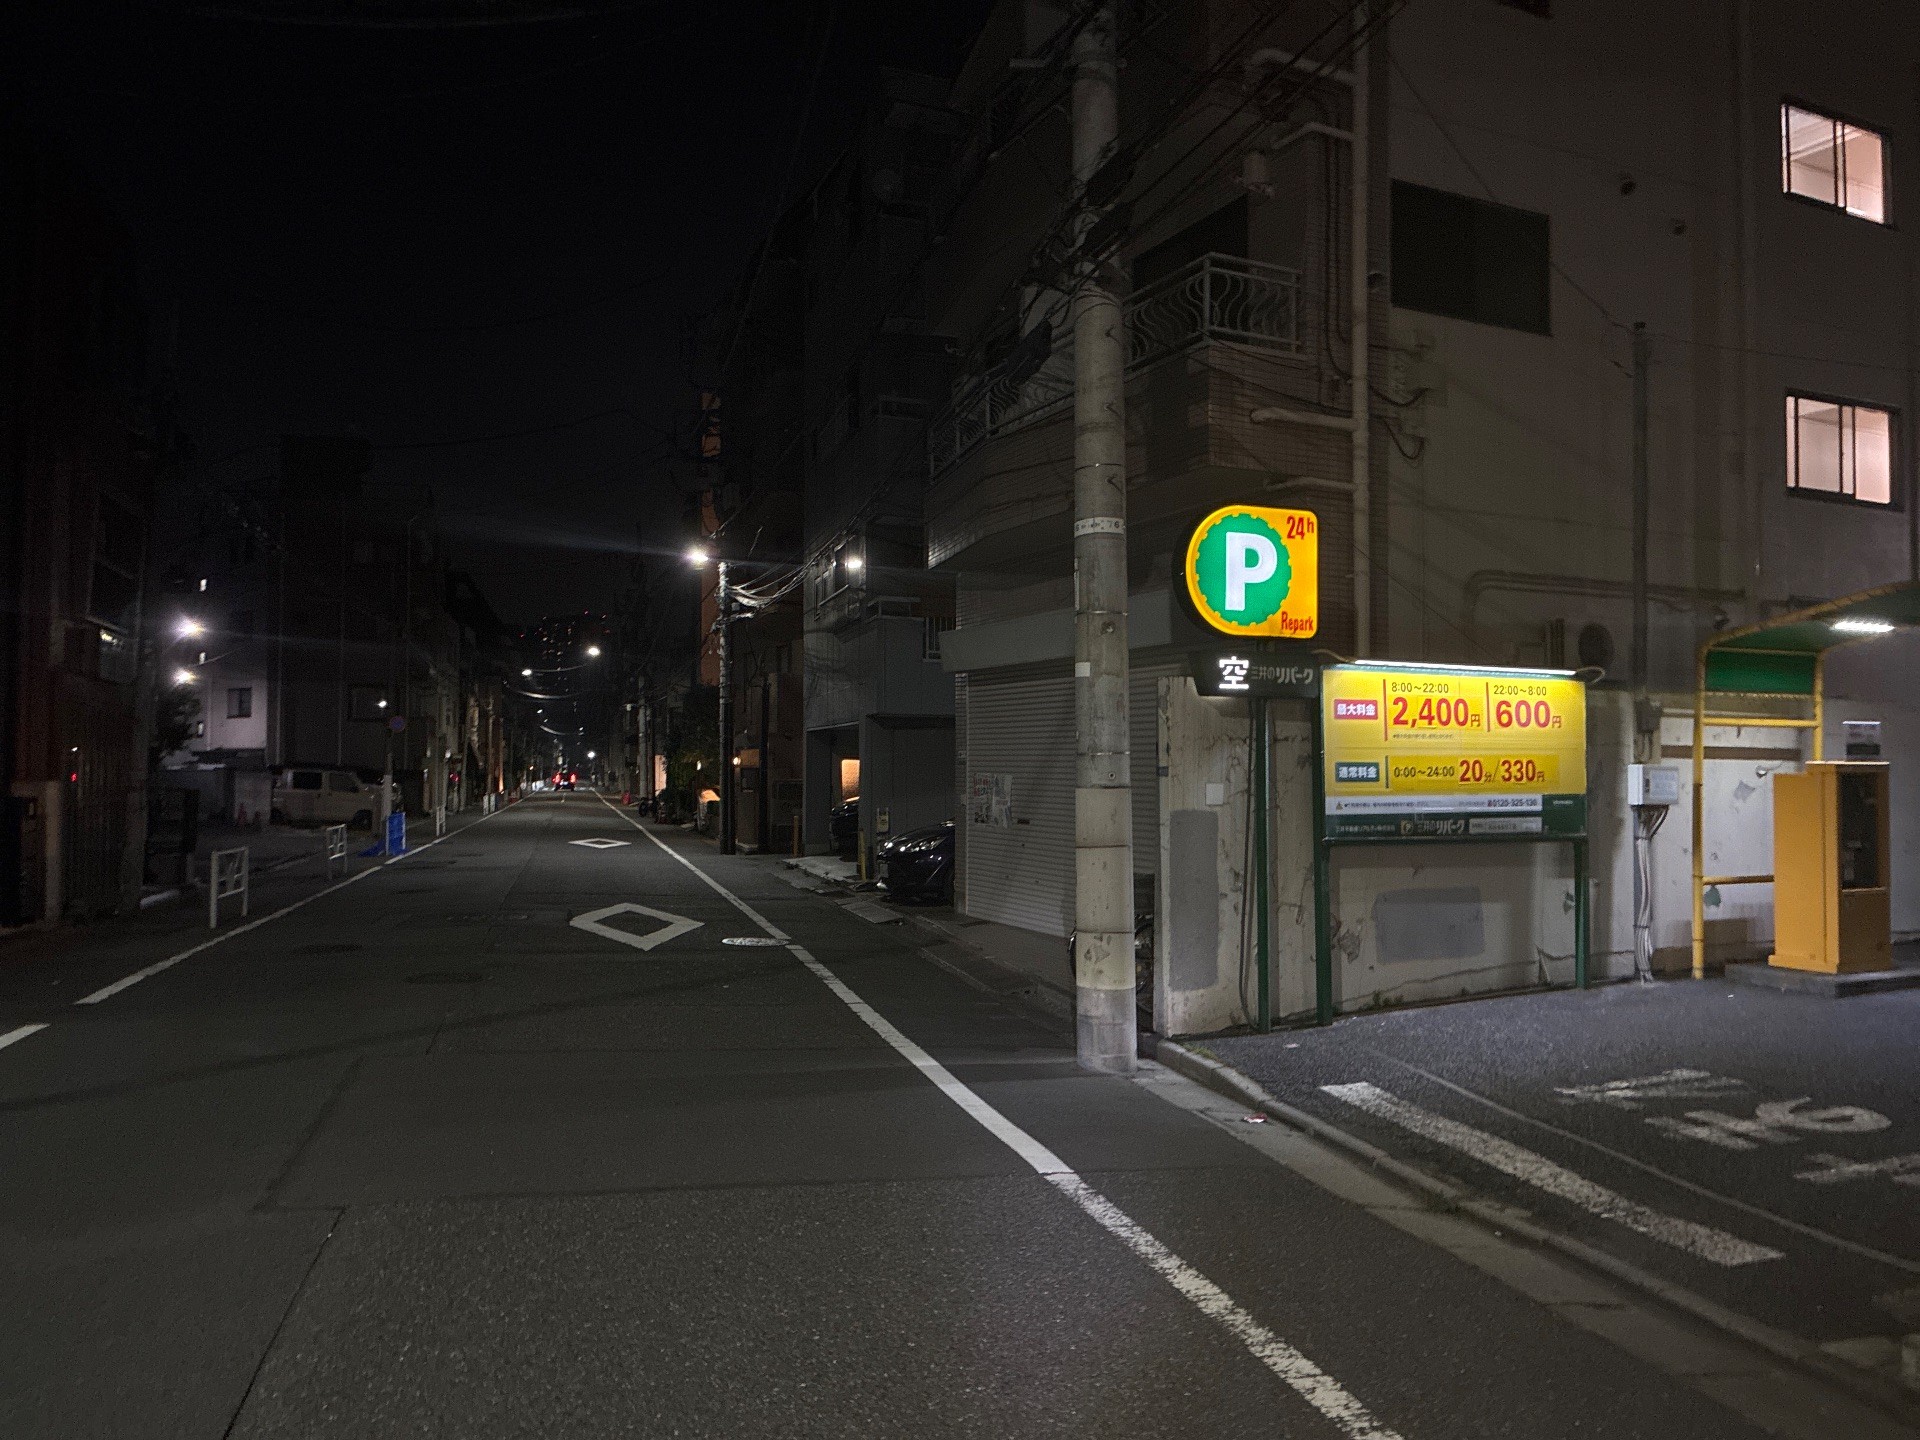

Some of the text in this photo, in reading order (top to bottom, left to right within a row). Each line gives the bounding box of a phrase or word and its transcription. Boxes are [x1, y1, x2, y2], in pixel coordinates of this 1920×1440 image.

[1286, 516, 1315, 540] 24h
[1225, 532, 1278, 611] P
[1281, 611, 1314, 634] Repark
[1219, 655, 1249, 690] 空
[1251, 666, 1313, 684] 三井のリパーク
[1337, 704, 1376, 716] 最大料金
[1393, 697, 1480, 728] 2,400円
[1496, 700, 1562, 728] 600円
[1339, 766, 1378, 779] 通常料金
